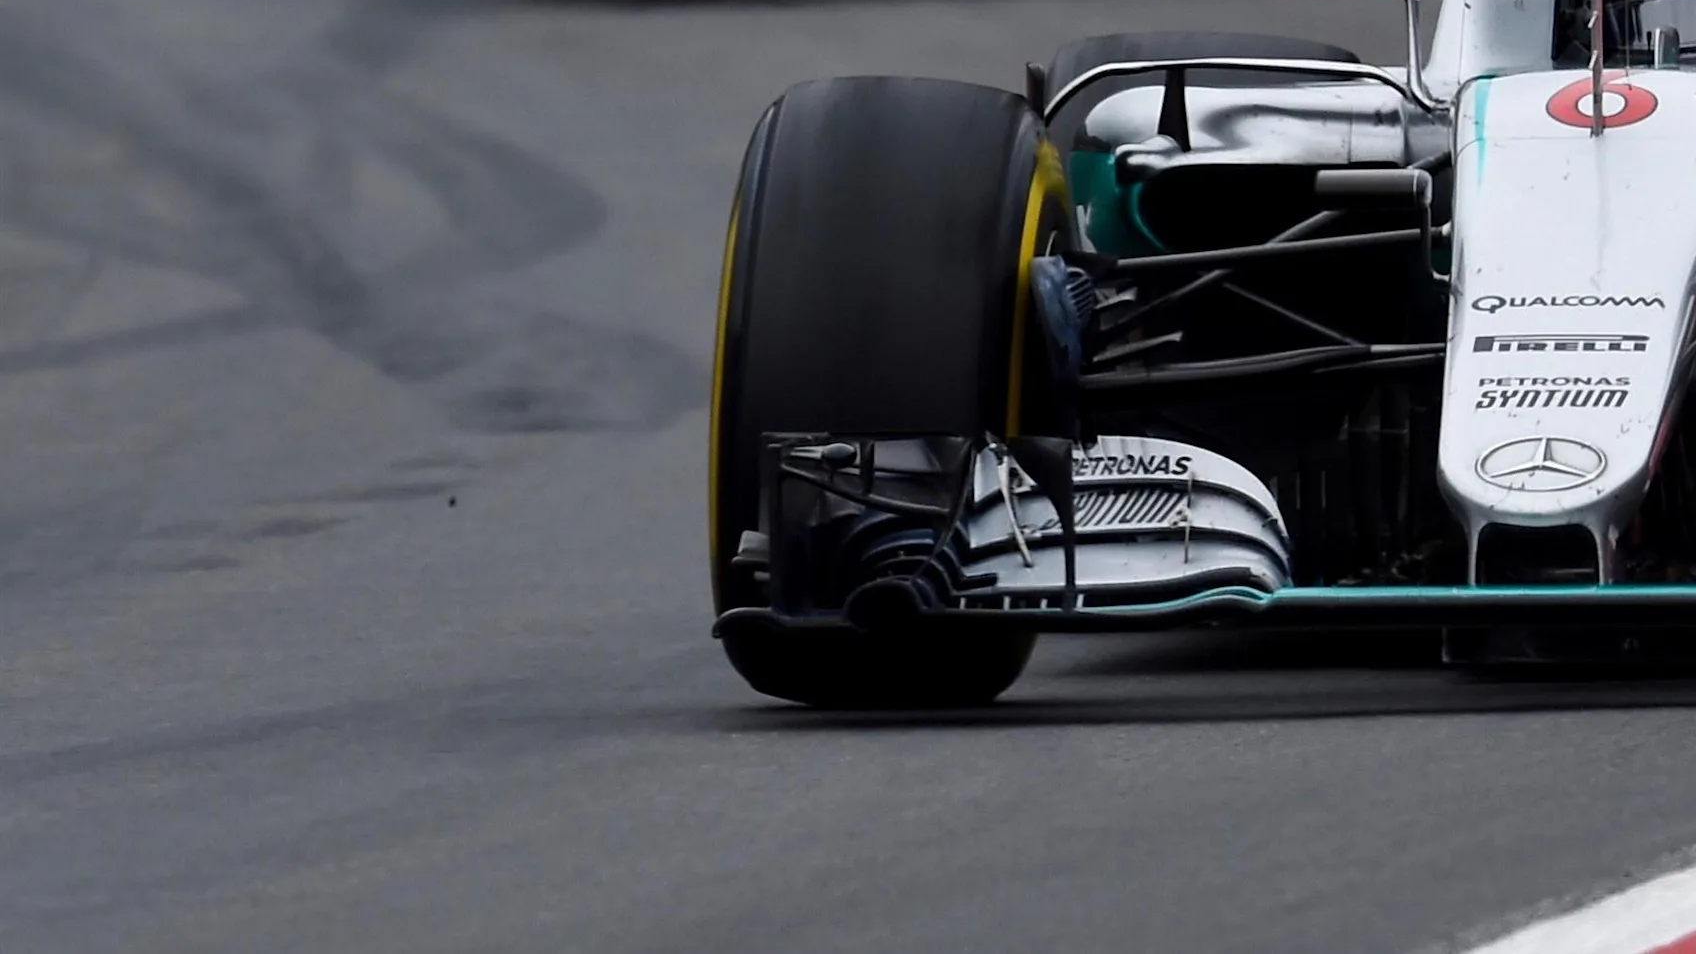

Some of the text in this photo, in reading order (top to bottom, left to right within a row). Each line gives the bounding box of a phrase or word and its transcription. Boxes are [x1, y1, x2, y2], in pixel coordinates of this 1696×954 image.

[1545, 67, 1659, 129] 6
[1471, 295, 1666, 314] QUALCOMM
[1472, 333, 1651, 353] PIRELLI
[1478, 376, 1632, 388] PETRONAS
[1475, 389, 1629, 410] SYNTIUM
